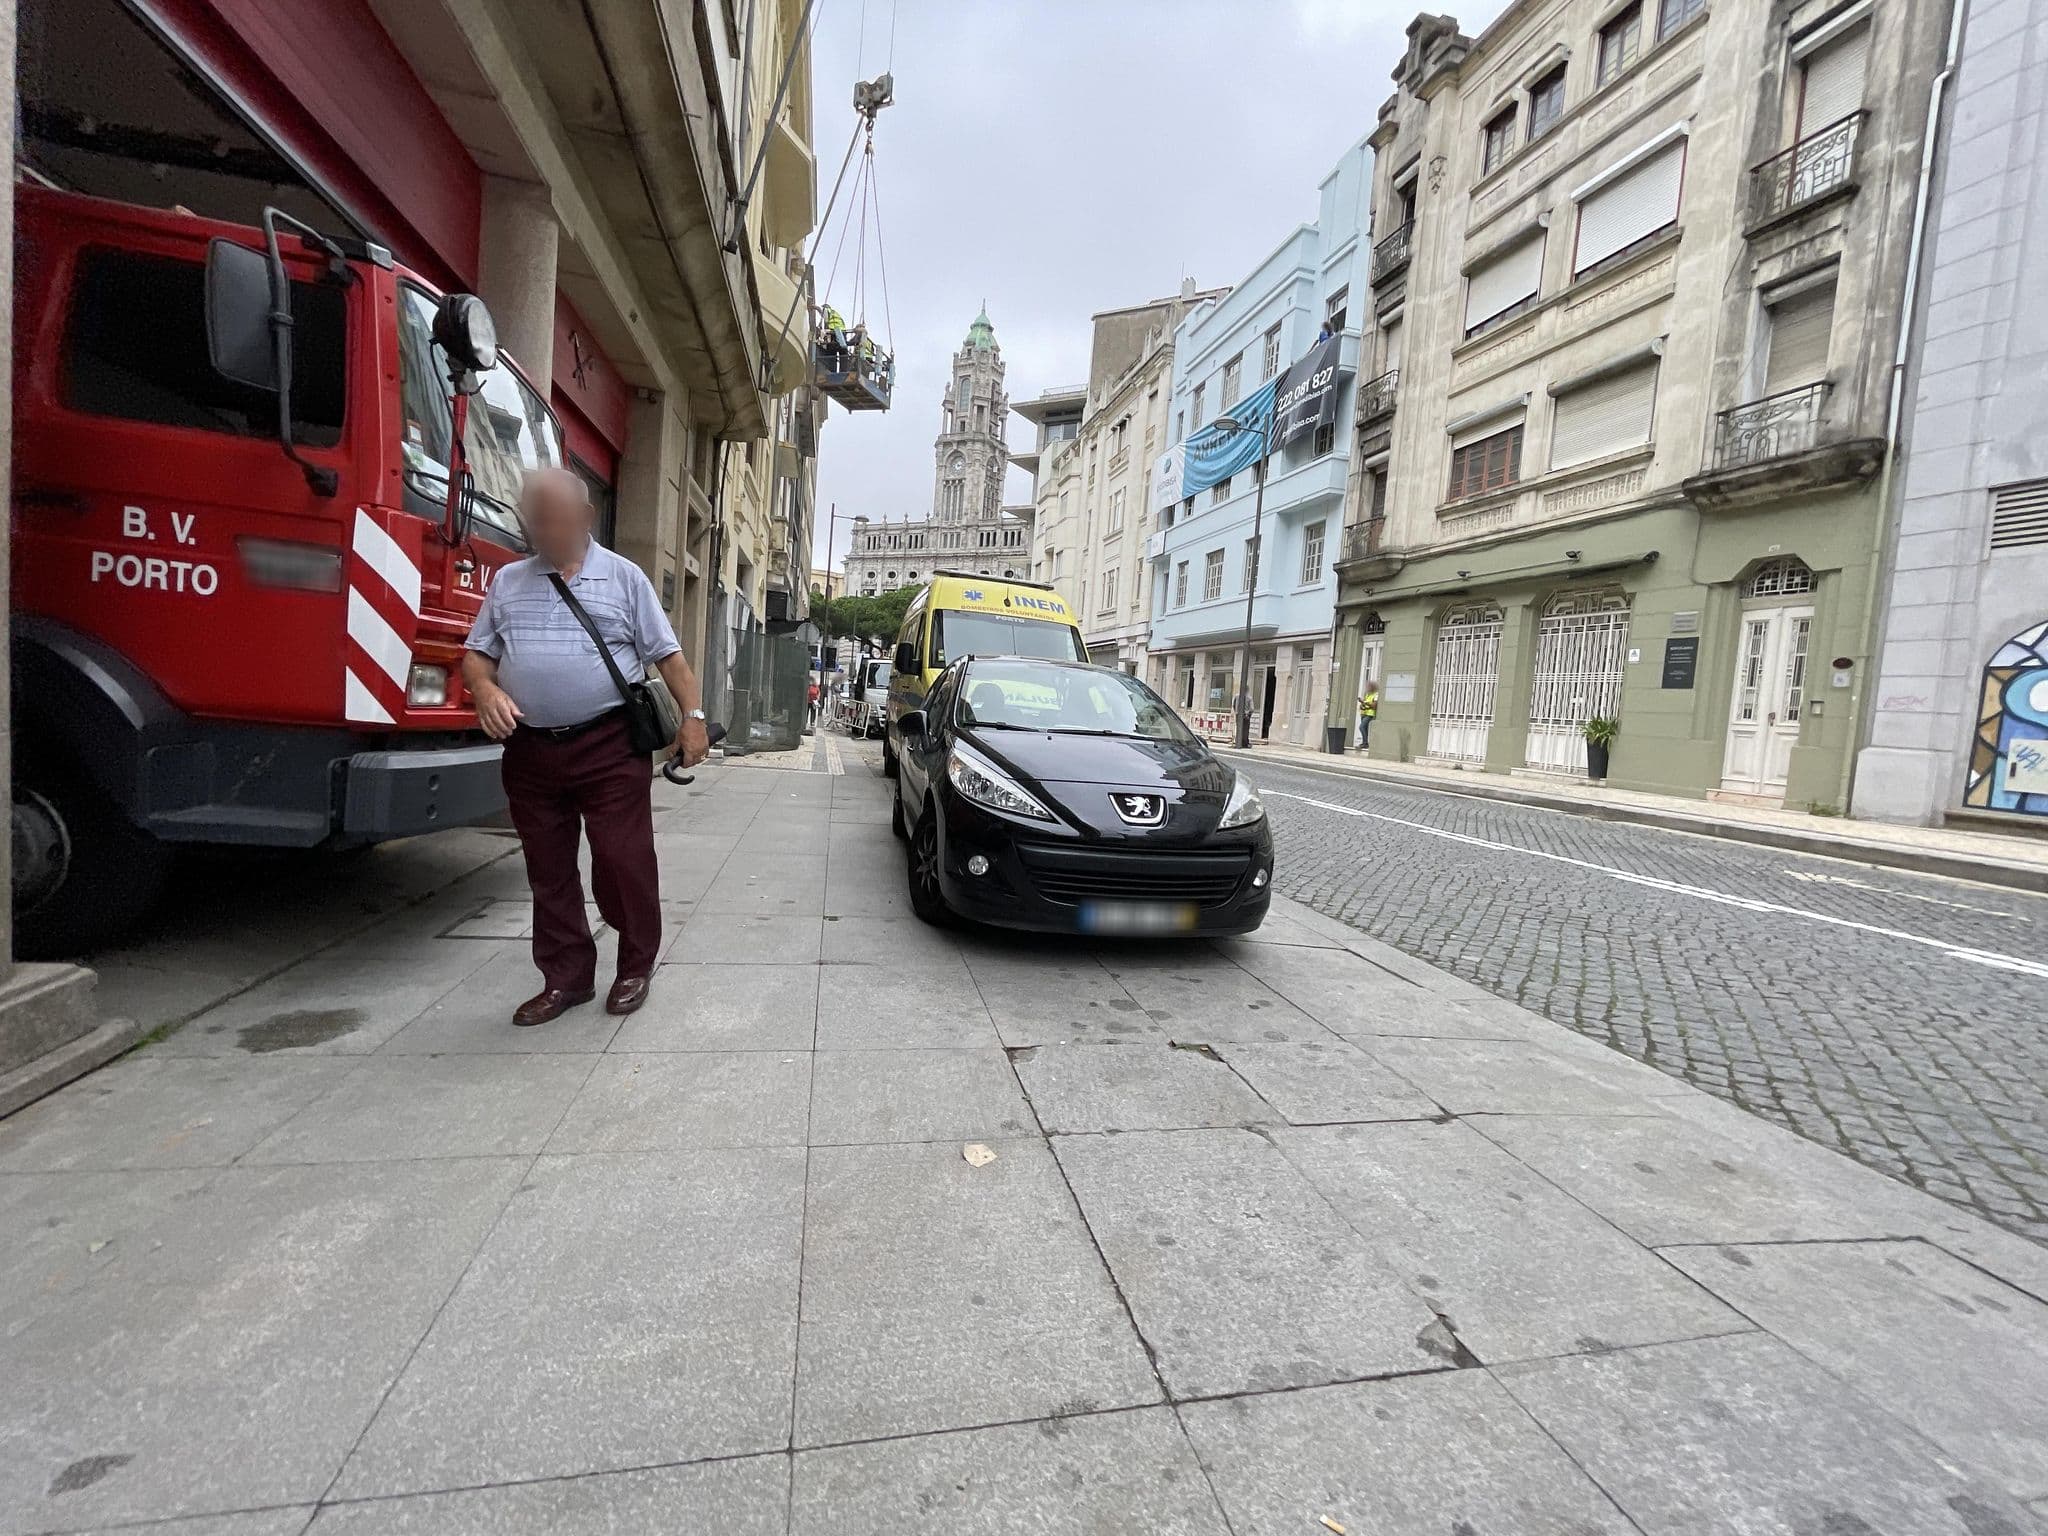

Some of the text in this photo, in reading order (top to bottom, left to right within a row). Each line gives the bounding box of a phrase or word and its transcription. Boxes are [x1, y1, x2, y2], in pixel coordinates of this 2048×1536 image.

[1277, 366, 1333, 412] 222 081 827
[123, 505, 196, 546] B. V.
[91, 551, 219, 596] PORTO
[960, 605, 1004, 613] BOMBEIROS
[1014, 595, 1066, 615] INEM
